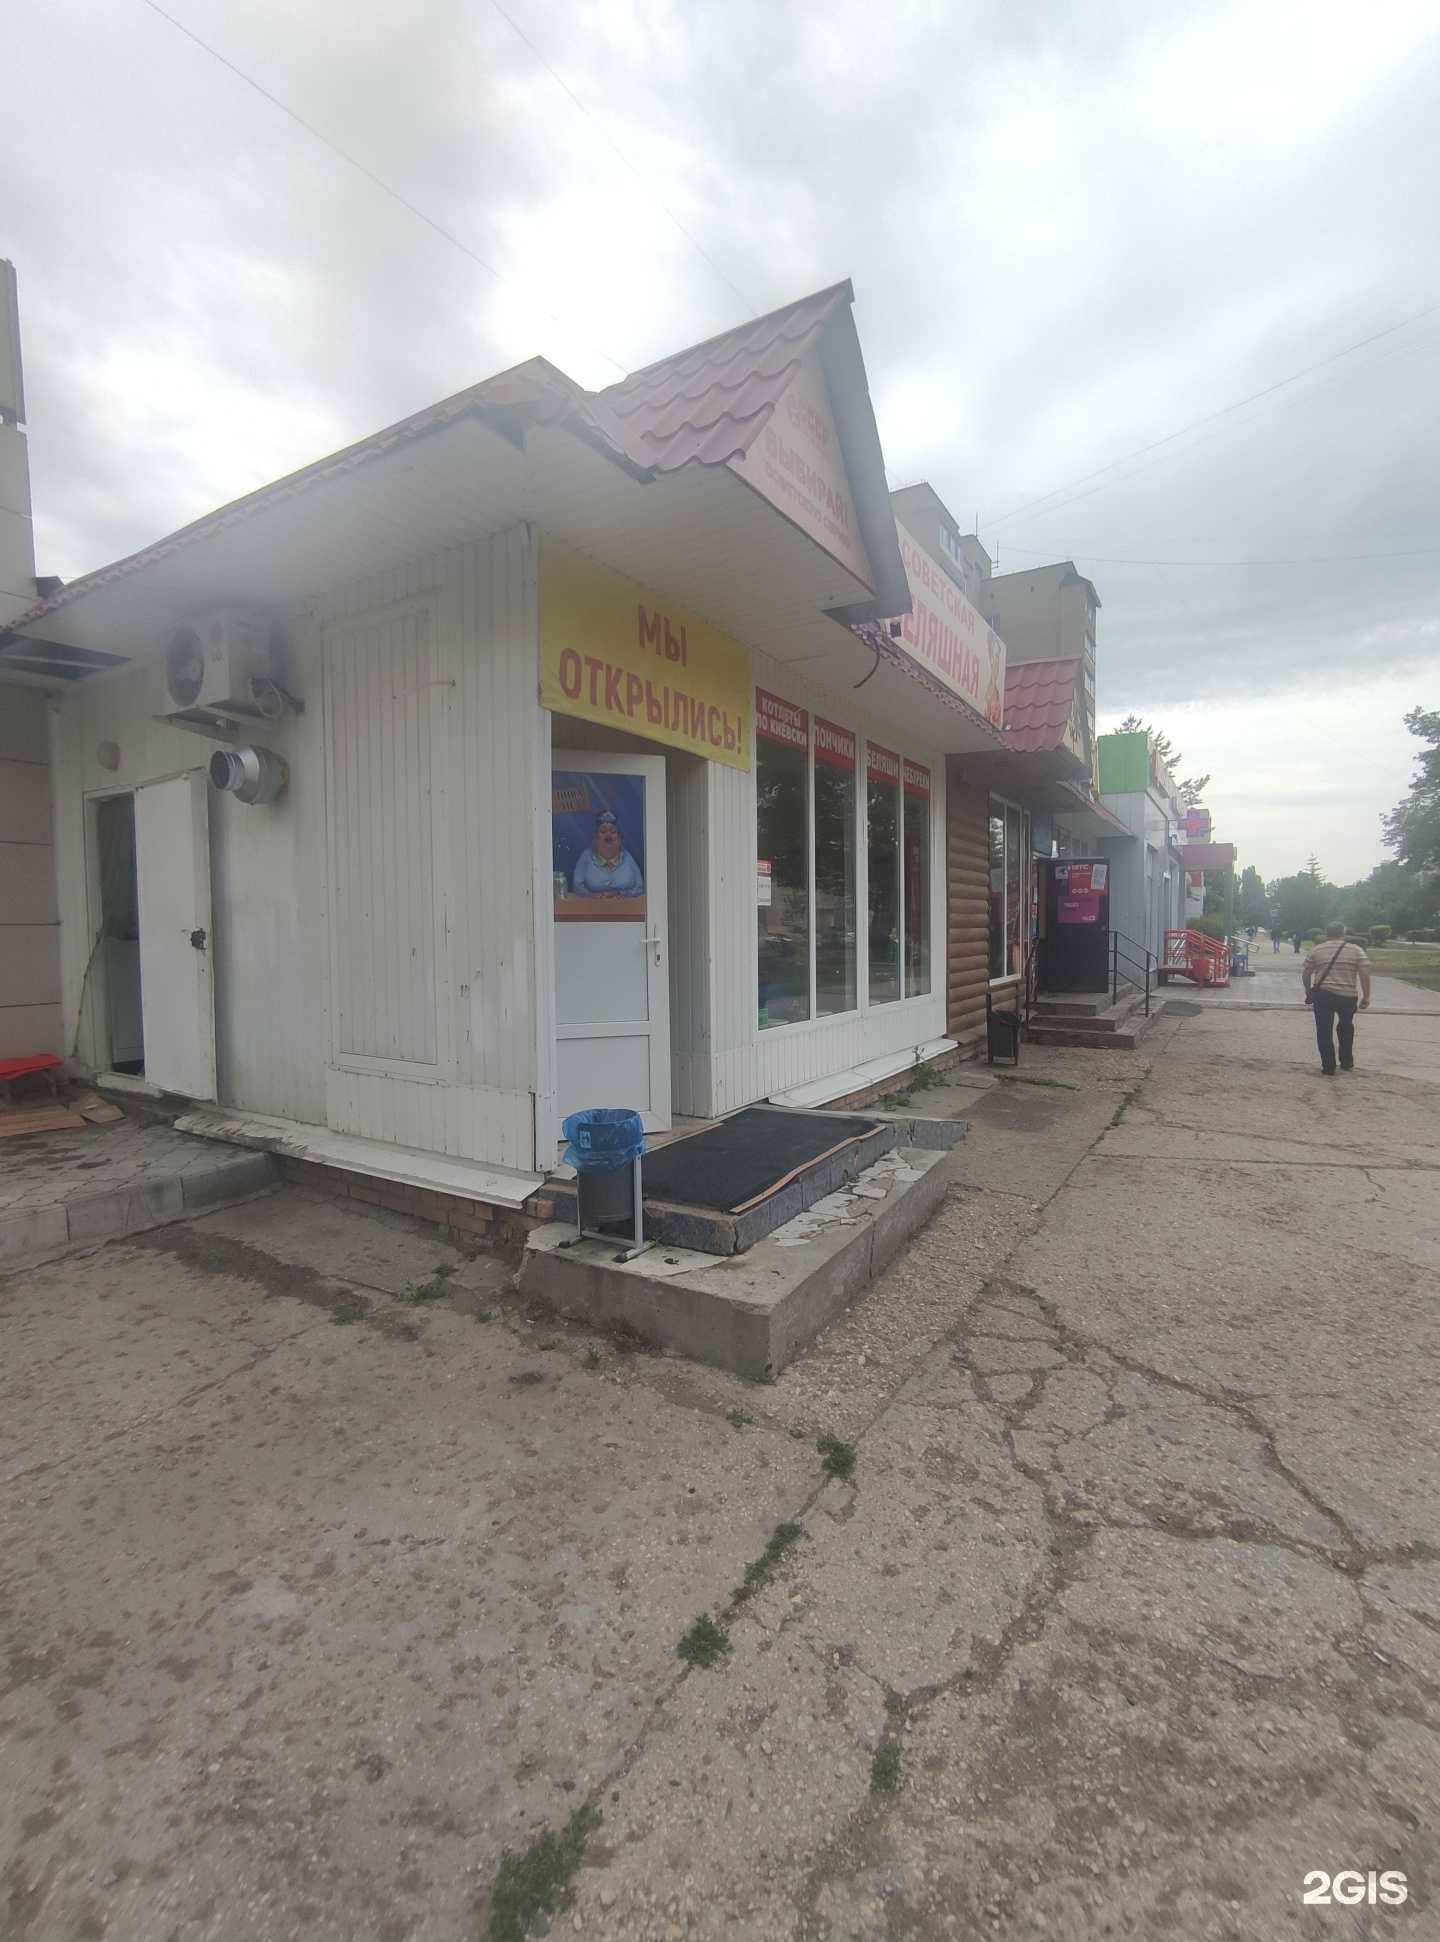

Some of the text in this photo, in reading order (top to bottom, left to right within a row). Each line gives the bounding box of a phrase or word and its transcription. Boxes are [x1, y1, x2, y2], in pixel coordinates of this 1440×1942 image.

[902, 540, 975, 636] СОВЕТСКАЯ
[638, 603, 687, 667] МЫ
[889, 596, 979, 698] ЕЛЯШНАЯ
[559, 647, 742, 755] ОТКРЫЛИСЬ!
[761, 696, 801, 727] КОТЛЕТЫ
[814, 726, 856, 761] ПОНЧИКИ
